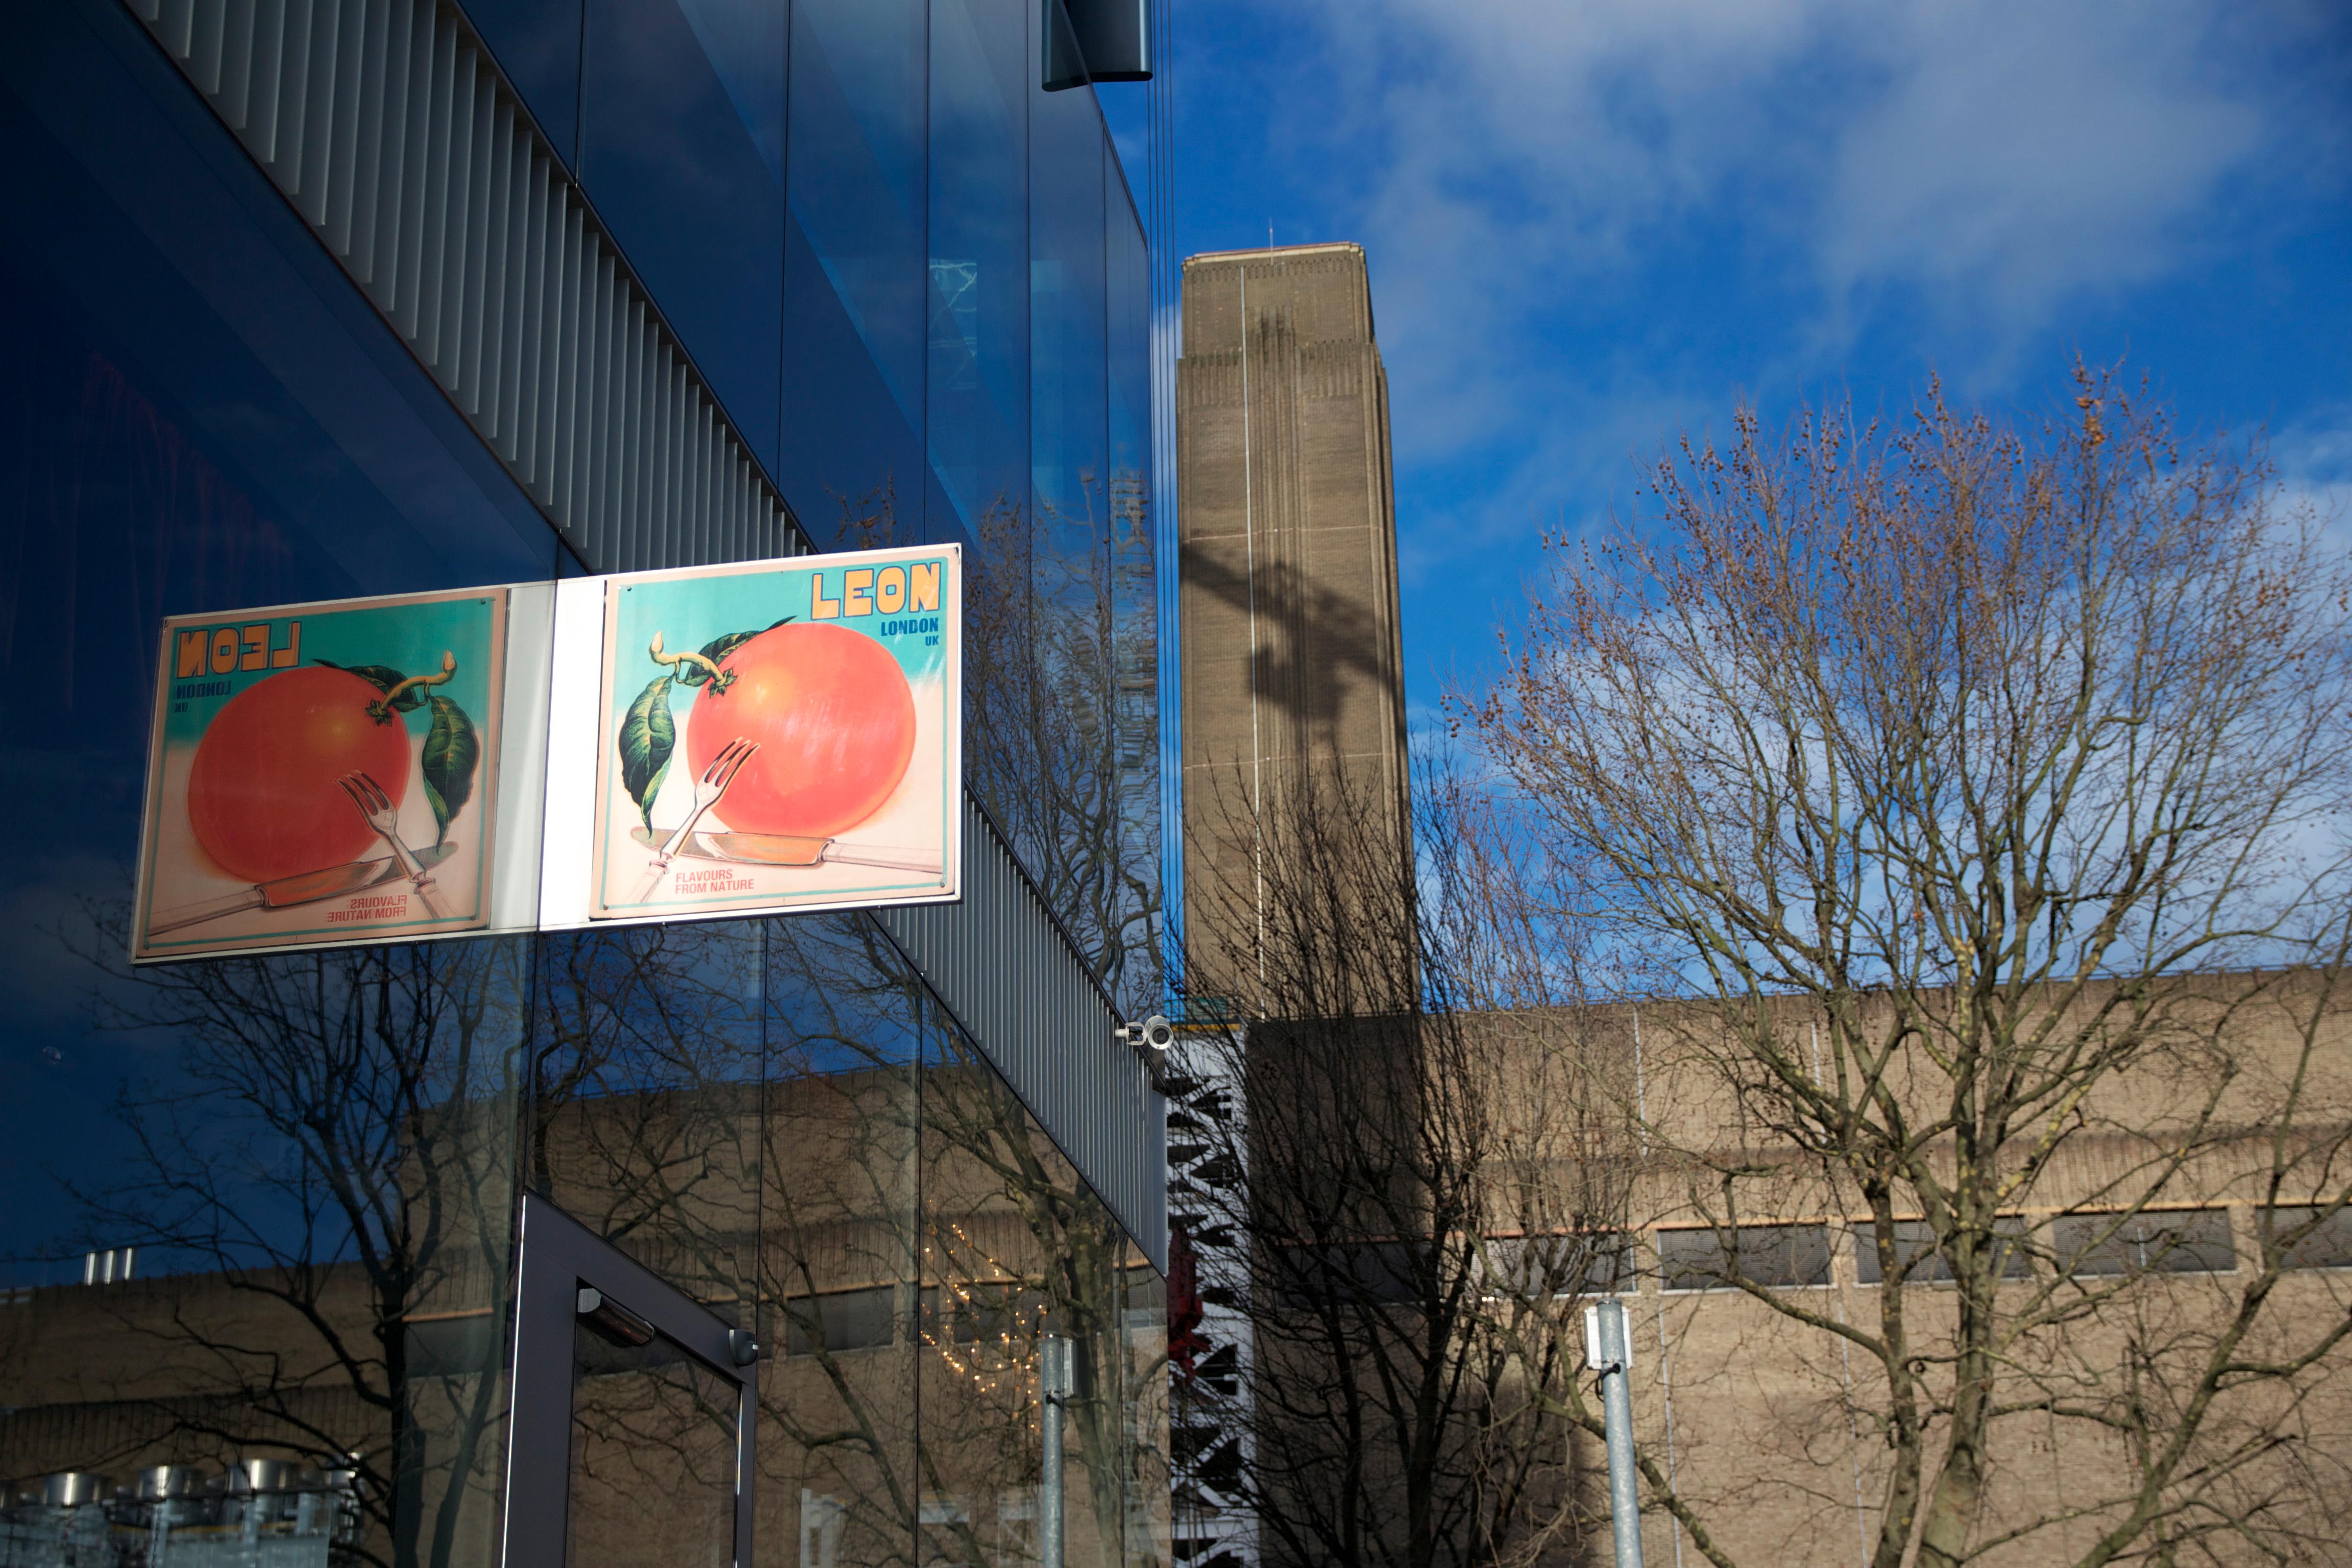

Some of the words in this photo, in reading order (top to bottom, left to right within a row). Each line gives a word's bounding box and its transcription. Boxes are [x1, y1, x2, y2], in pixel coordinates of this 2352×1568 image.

[811, 562, 941, 621] LEON
[881, 618, 938, 636] LONDON
[925, 635, 939, 646] UK
[676, 869, 732, 883] FLAVOURS
[675, 883, 706, 894] FROM
[710, 879, 754, 892] NATURE
